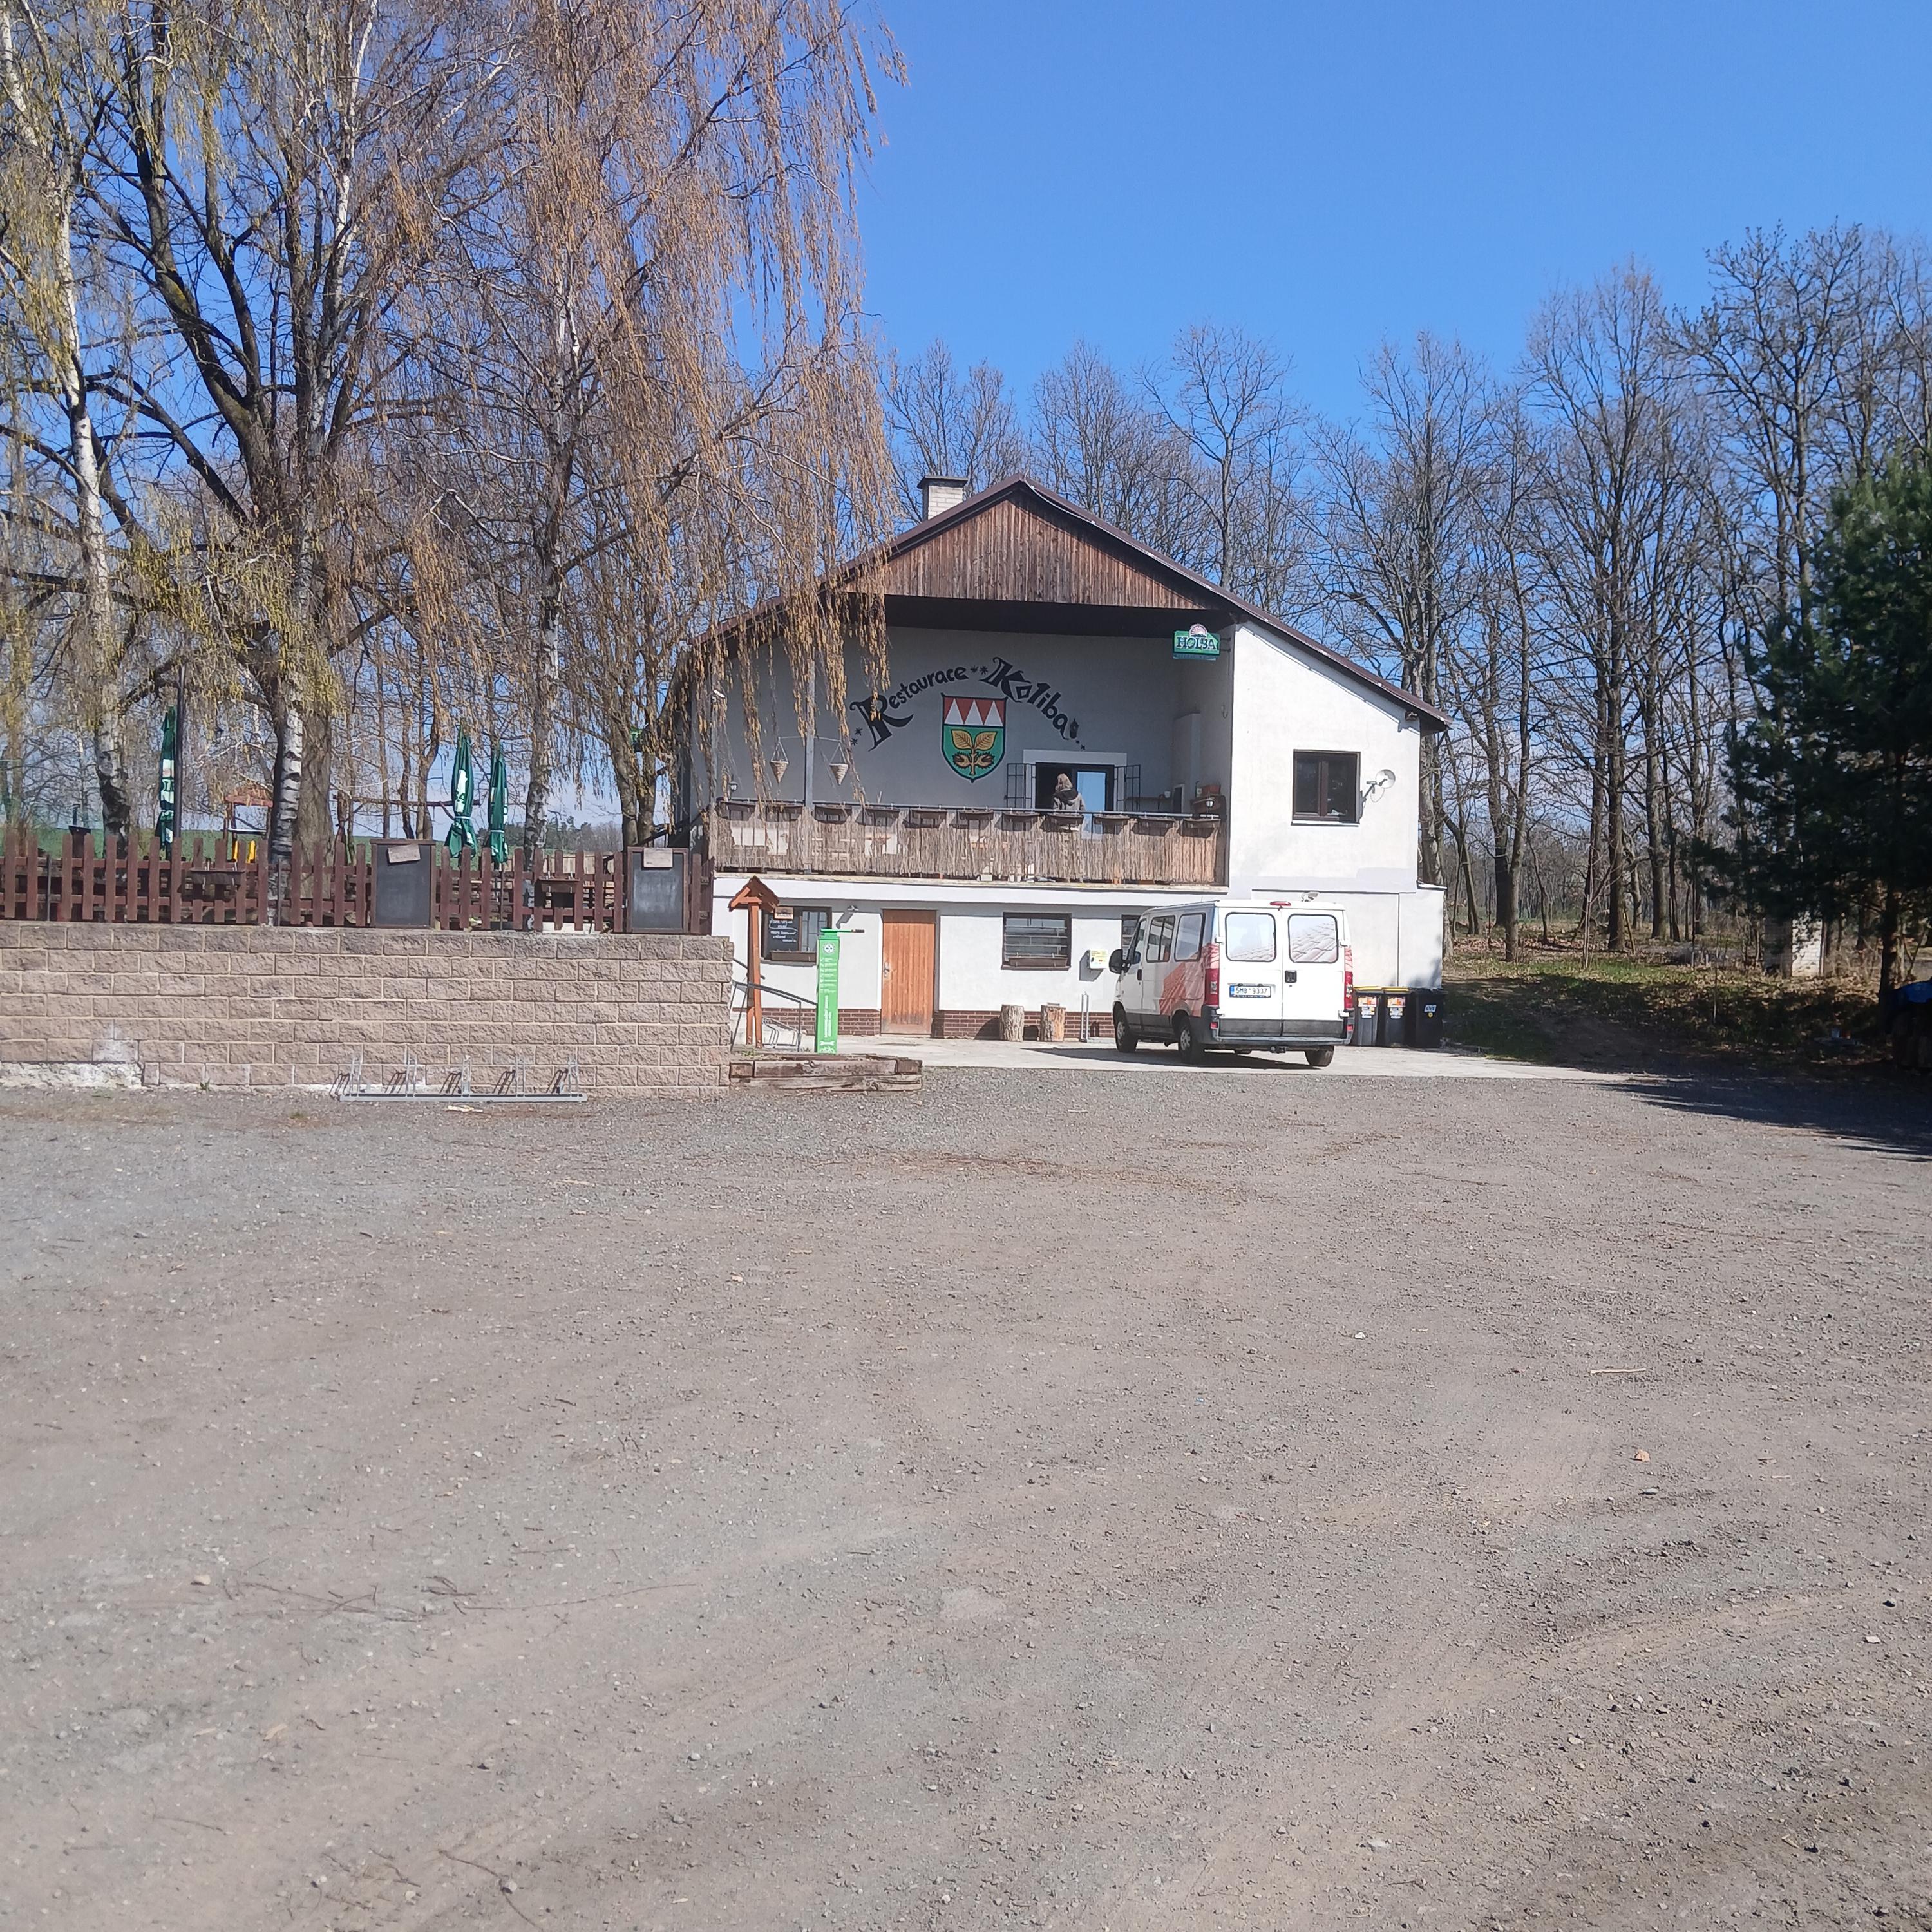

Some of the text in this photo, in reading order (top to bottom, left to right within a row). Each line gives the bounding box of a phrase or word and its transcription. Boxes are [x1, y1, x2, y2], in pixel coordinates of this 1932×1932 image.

[1177, 636, 1216, 650] HOLBA
[849, 656, 1070, 752] Restaurace Koliba
